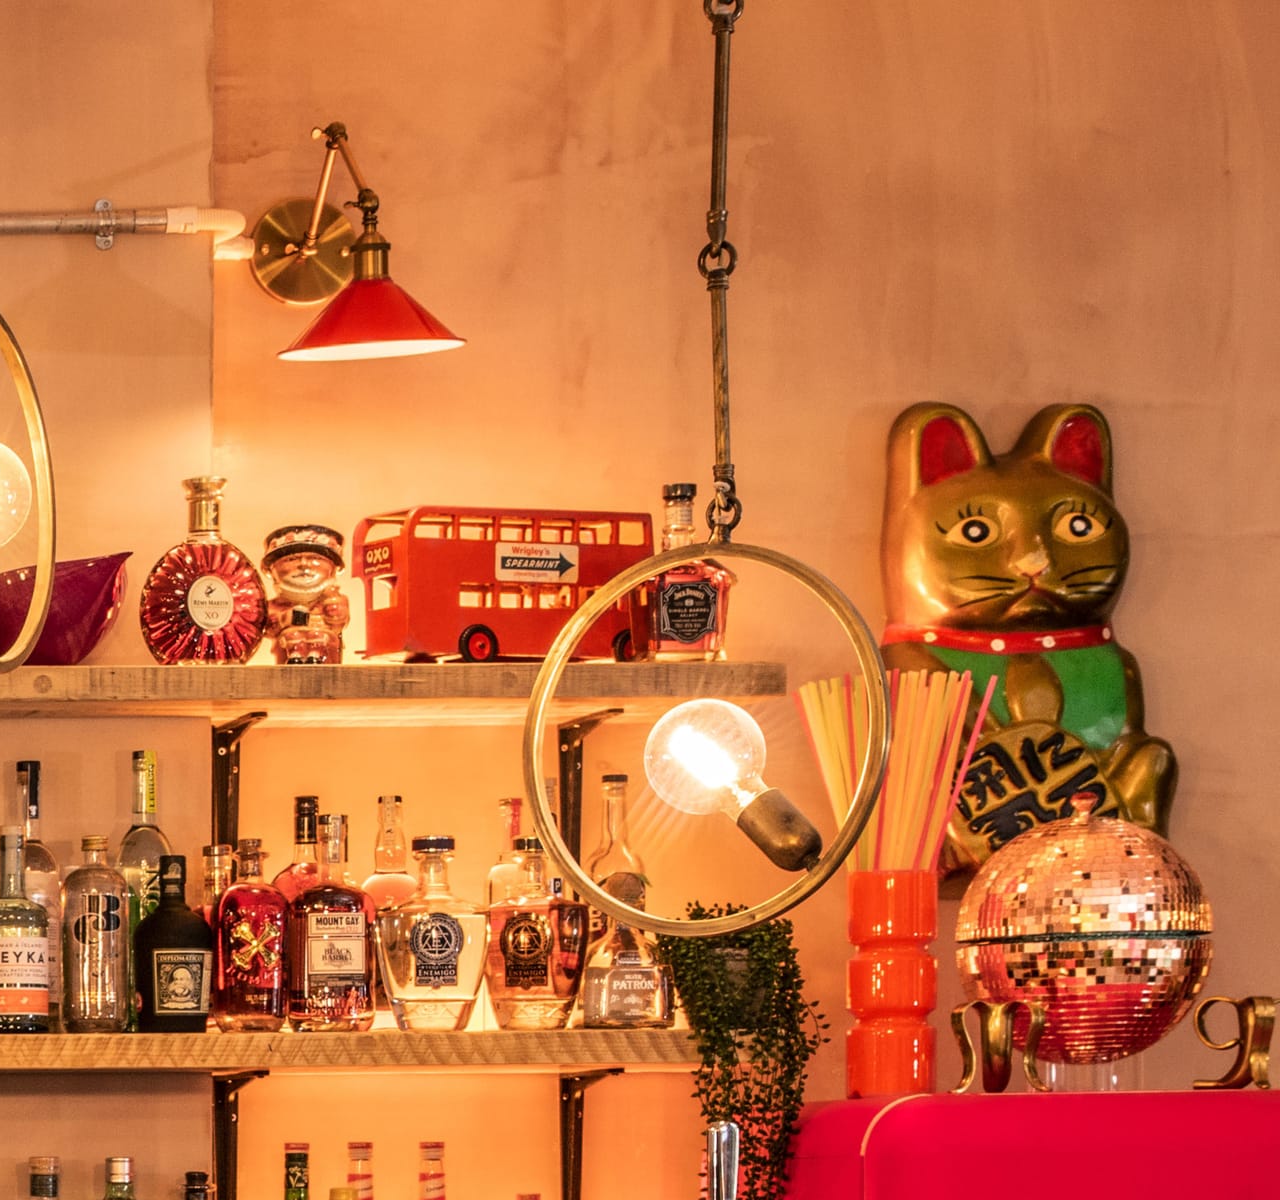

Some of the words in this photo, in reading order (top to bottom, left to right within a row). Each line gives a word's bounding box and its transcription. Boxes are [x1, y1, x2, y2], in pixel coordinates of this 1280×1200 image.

[366, 545, 390, 564] OXO
[511, 545, 551, 557] Wrigley's
[504, 558, 560, 569] SPEARMINT
[204, 611, 219, 620] XO
[315, 916, 344, 926] MOUNT
[345, 916, 359, 926] GAY
[418, 969, 456, 977] ENEMIGO
[508, 969, 545, 977] ENEMIGO
